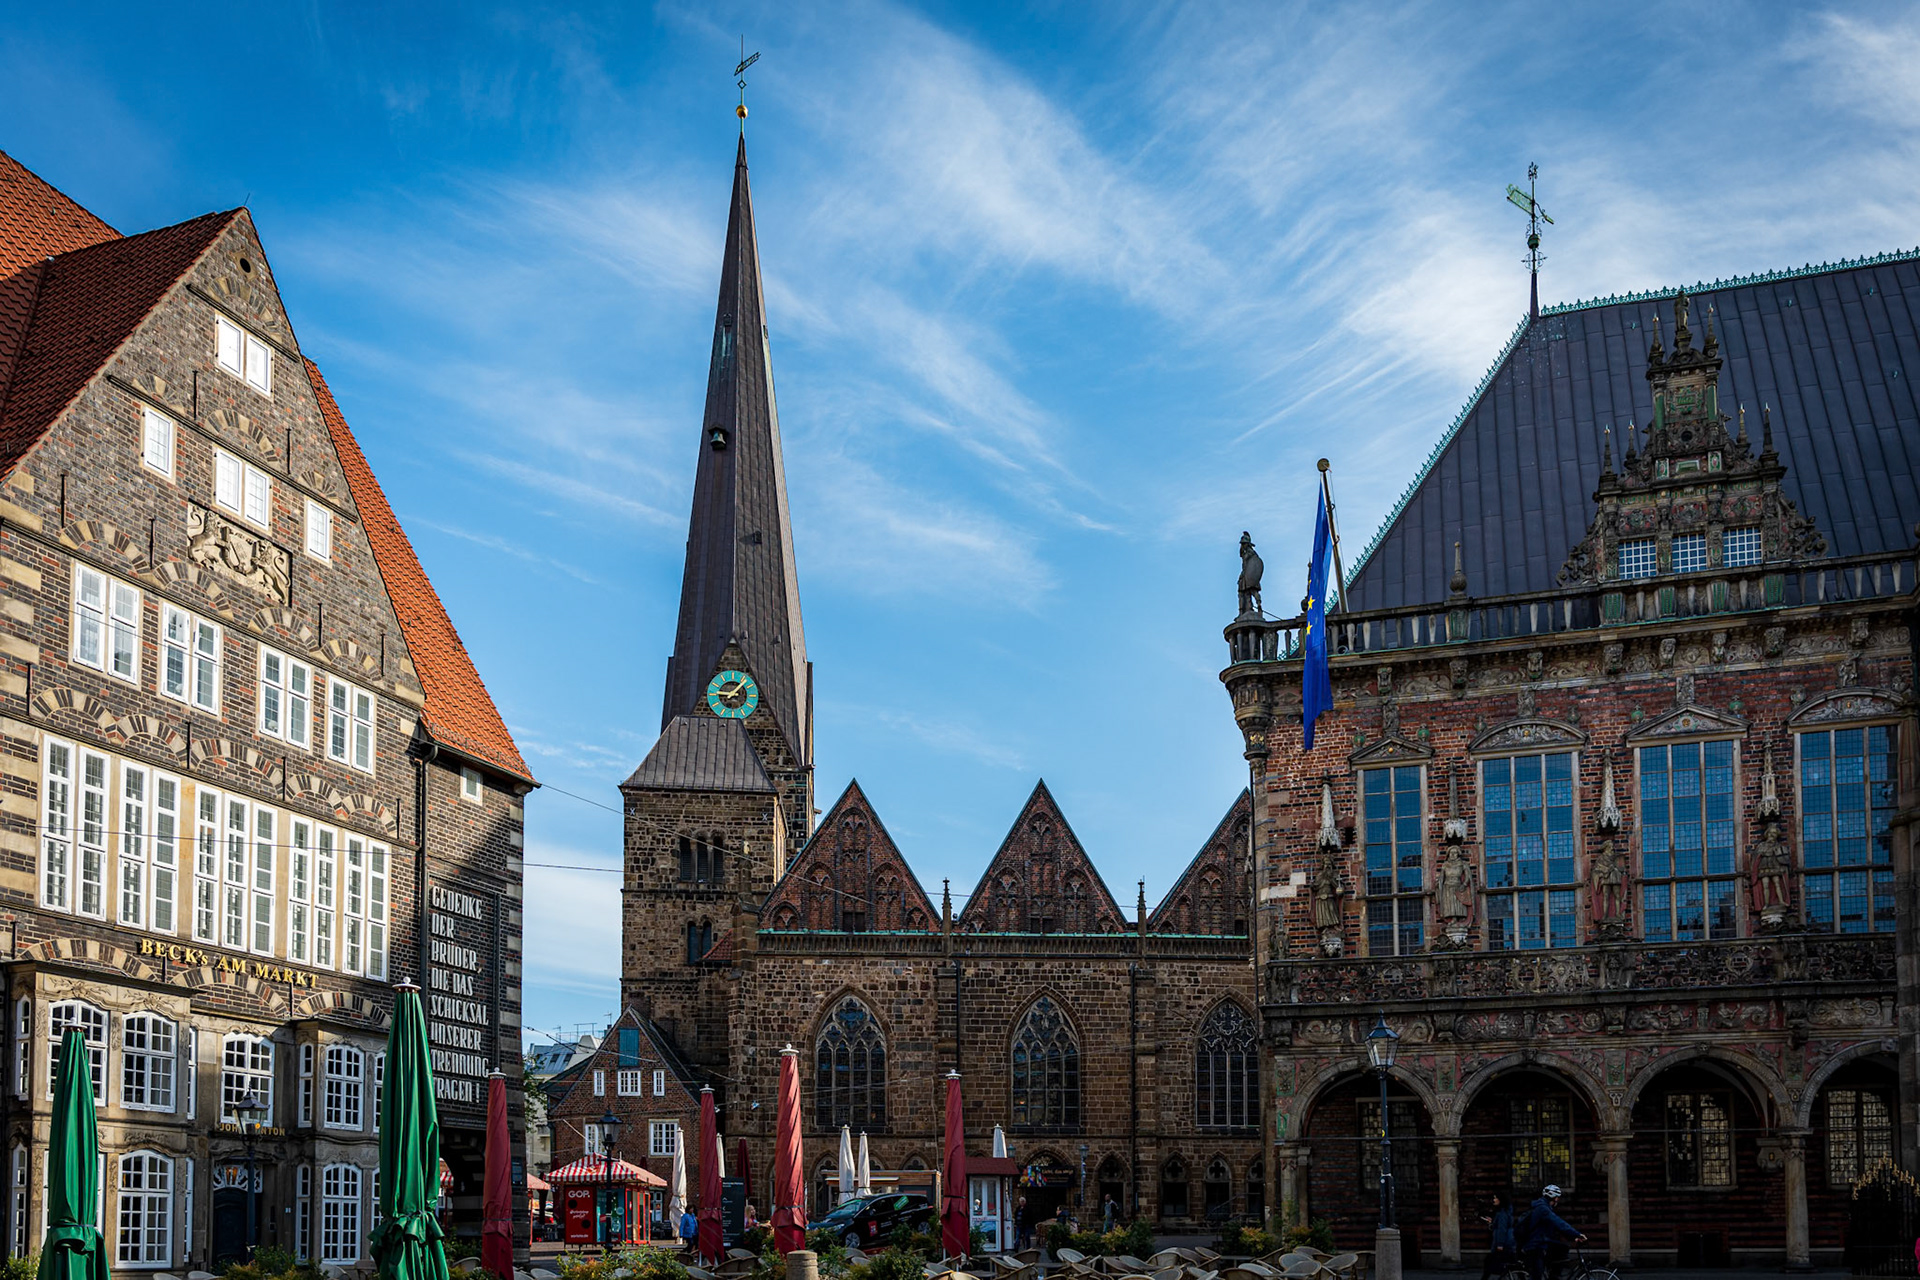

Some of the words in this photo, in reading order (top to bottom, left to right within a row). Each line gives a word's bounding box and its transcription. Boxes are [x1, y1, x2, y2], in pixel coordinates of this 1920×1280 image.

[432, 885, 482, 920] GEDENKE
[431, 912, 455, 939] DER
[217, 955, 247, 974] AM
[255, 962, 319, 988] MARKT
[431, 939, 482, 974] BRÜDER,
[431, 967, 449, 992] DIE
[452, 972, 473, 997] DAS
[430, 994, 489, 1026] SCHICKSAL
[430, 1021, 482, 1051] UNSERER
[430, 1048, 490, 1079] TRENNUNG
[568, 1190, 590, 1198] GOP.
